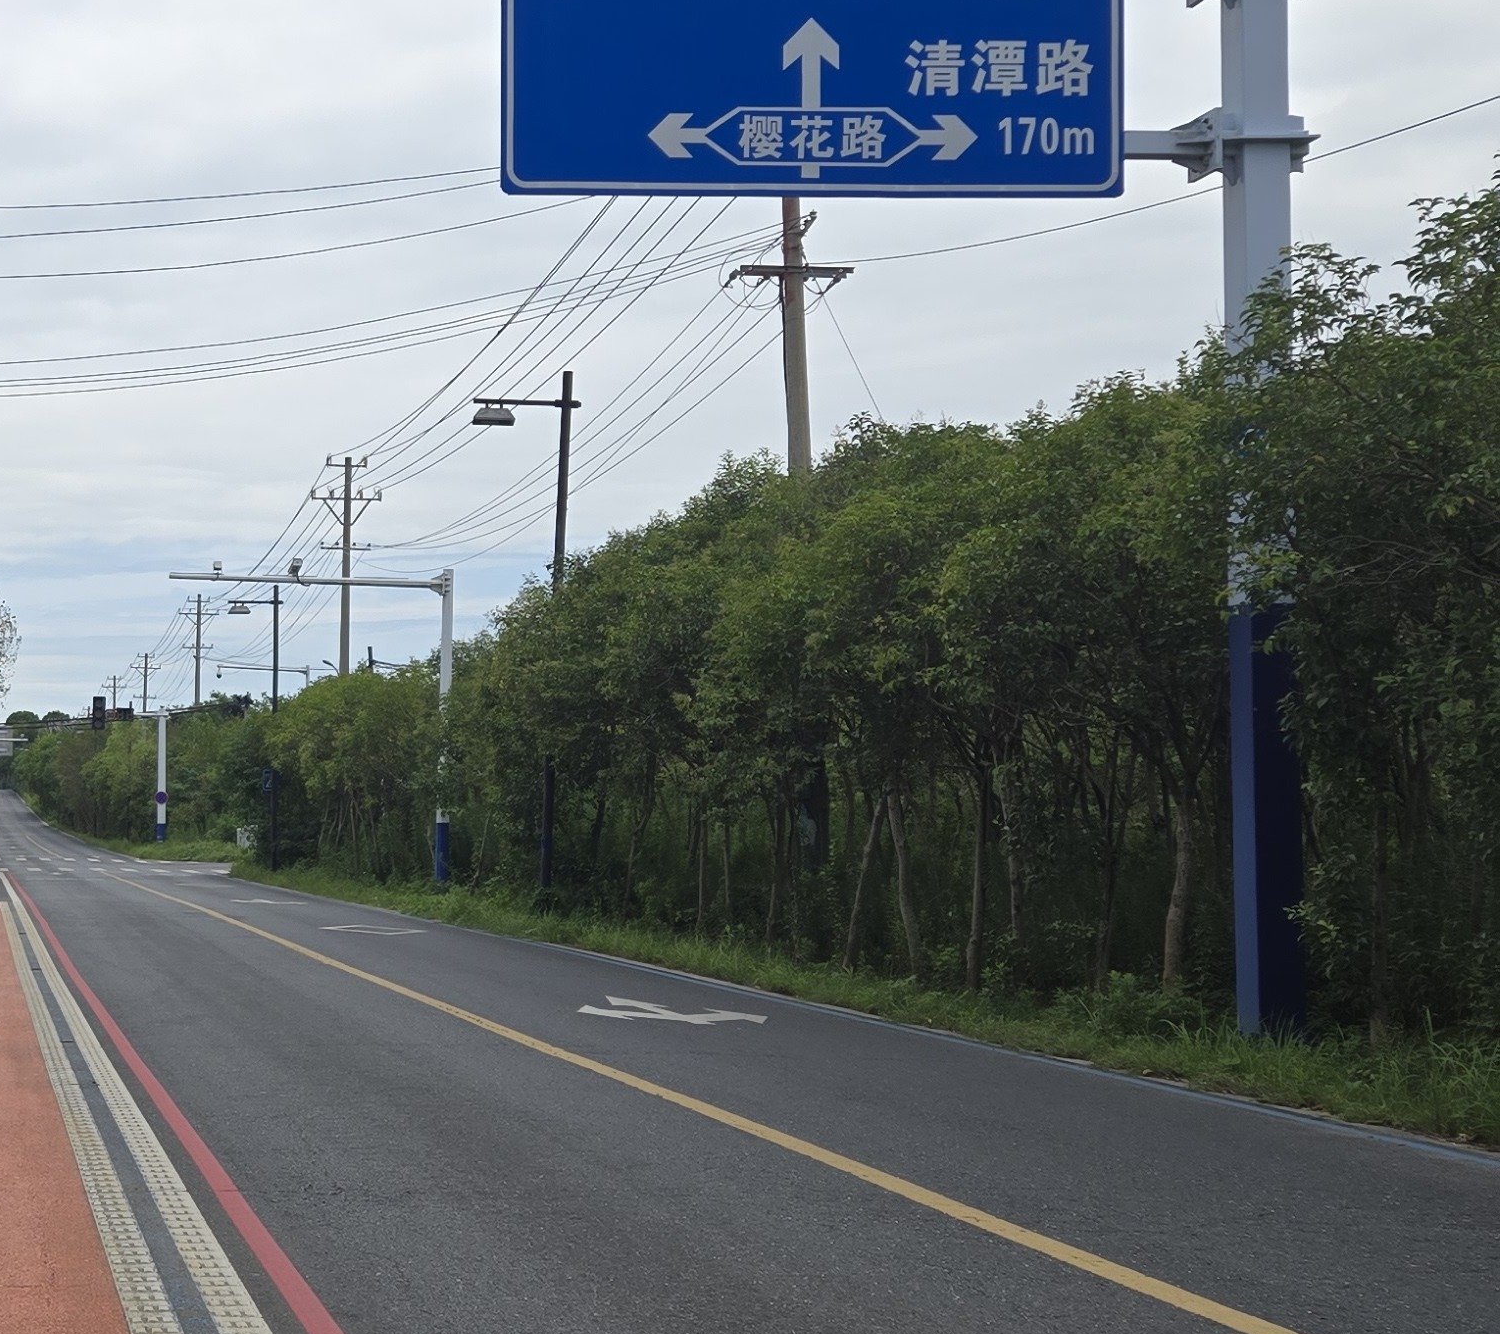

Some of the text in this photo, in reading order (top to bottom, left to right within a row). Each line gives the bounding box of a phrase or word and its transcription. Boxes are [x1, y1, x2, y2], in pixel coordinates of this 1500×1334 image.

[904, 39, 1094, 97] 清潭路
[738, 115, 887, 159] 樱花路
[997, 116, 1096, 156] 170m
